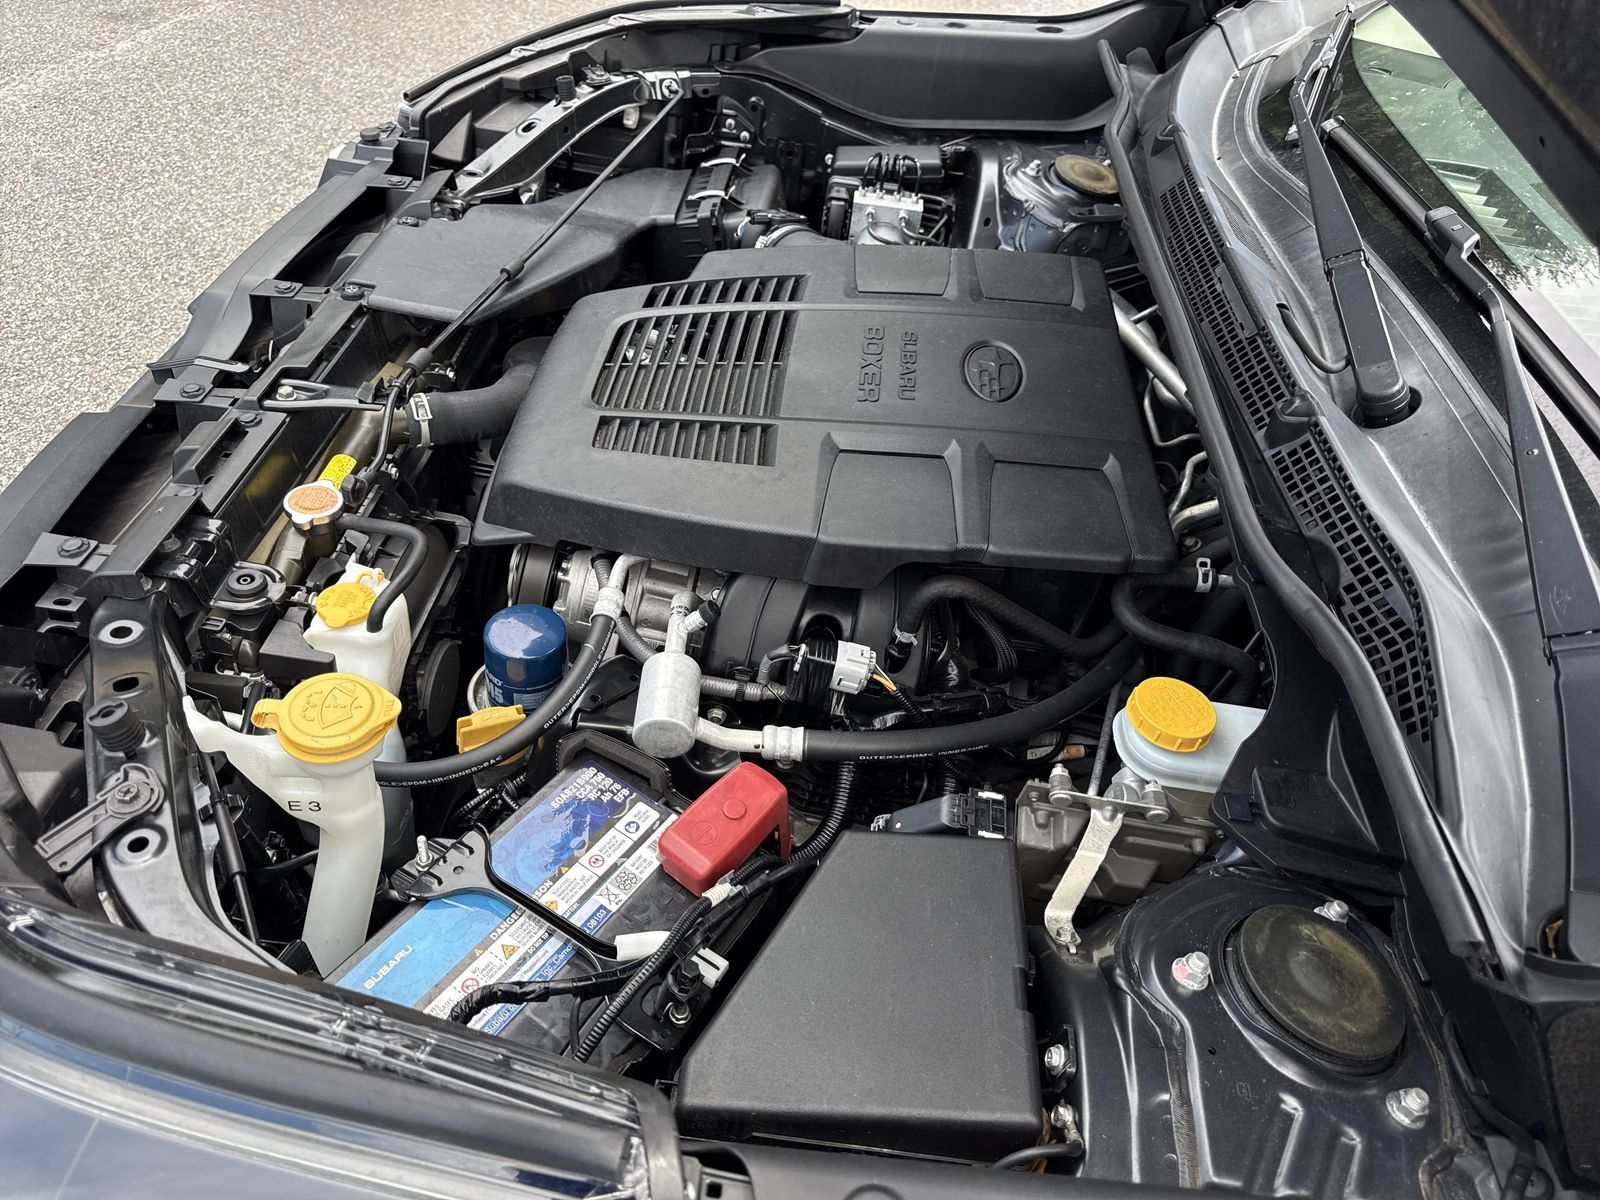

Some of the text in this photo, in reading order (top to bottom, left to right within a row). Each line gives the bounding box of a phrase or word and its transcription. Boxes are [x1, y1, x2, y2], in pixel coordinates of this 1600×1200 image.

[856, 325, 885, 404] BOXER
[898, 329, 918, 402] SUBARU
[575, 772, 605, 798] CCA 750
[587, 777, 613, 800] RC 120
[600, 783, 621, 801] Ah 76
[613, 788, 629, 802] EFB
[533, 939, 543, 947] NOT
[364, 945, 413, 990] SUBARU
[483, 1009, 510, 1033] Subaru
[540, 963, 555, 976] Inc.
[585, 908, 607, 927] 08103
